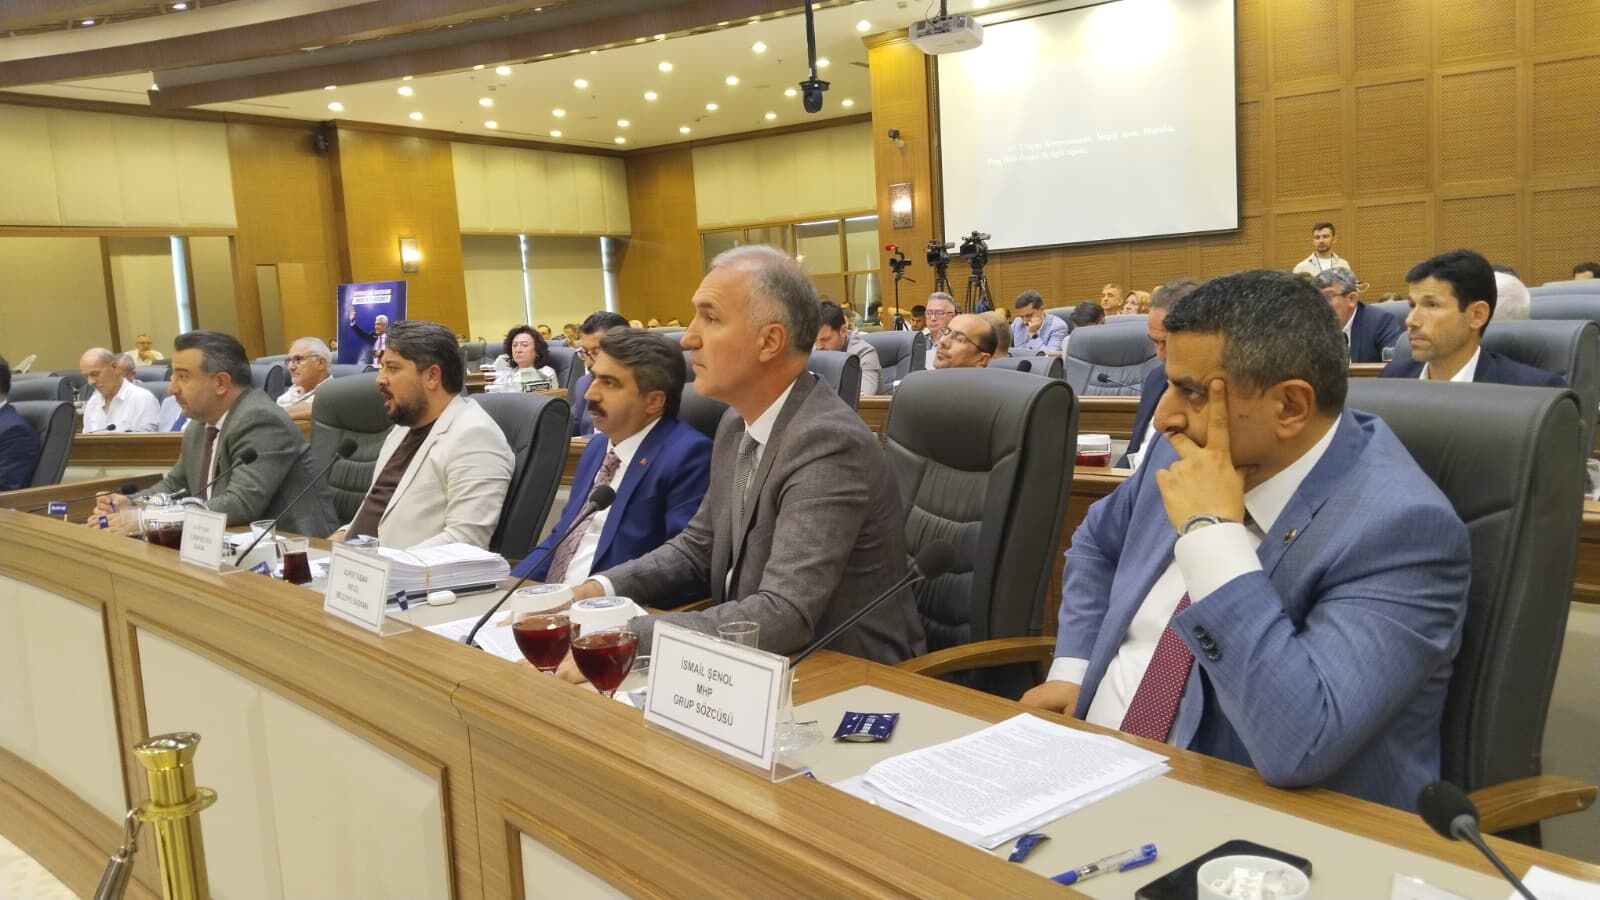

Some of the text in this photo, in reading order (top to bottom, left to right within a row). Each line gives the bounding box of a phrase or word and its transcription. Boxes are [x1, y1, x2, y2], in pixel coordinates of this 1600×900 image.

[681, 657, 734, 686] İSMAİL ŞENOL
[696, 683, 713, 697] MHP
[673, 694, 733, 725] GRUP SÖZCÜSÜ
